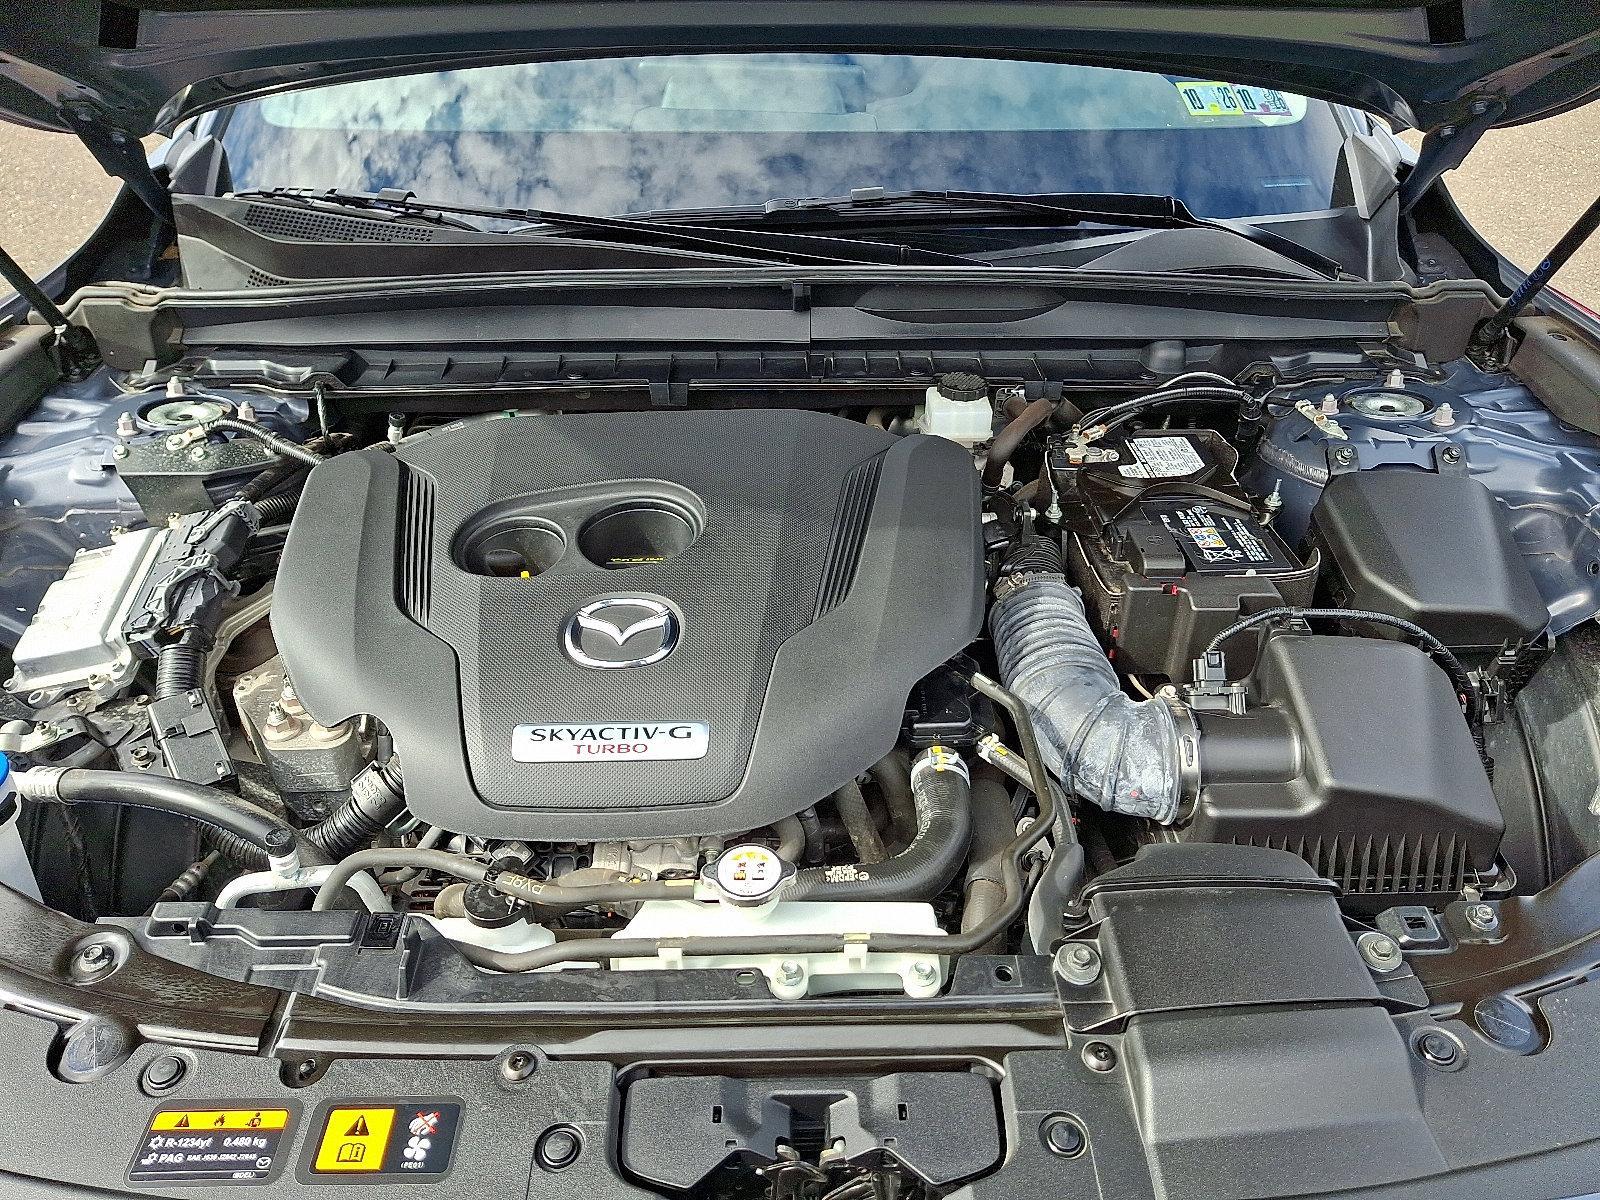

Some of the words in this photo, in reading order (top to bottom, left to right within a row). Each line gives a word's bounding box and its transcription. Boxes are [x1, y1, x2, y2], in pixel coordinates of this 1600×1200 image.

[1183, 88, 1205, 110] 10
[1217, 86, 1237, 109] 26
[1236, 89, 1257, 110] 10
[530, 726, 692, 742] SKYACTIV-G
[573, 743, 648, 755] TURBO
[164, 1136, 214, 1150] R-1234yf
[252, 1136, 268, 1149] kg
[158, 1152, 185, 1164] PAG
